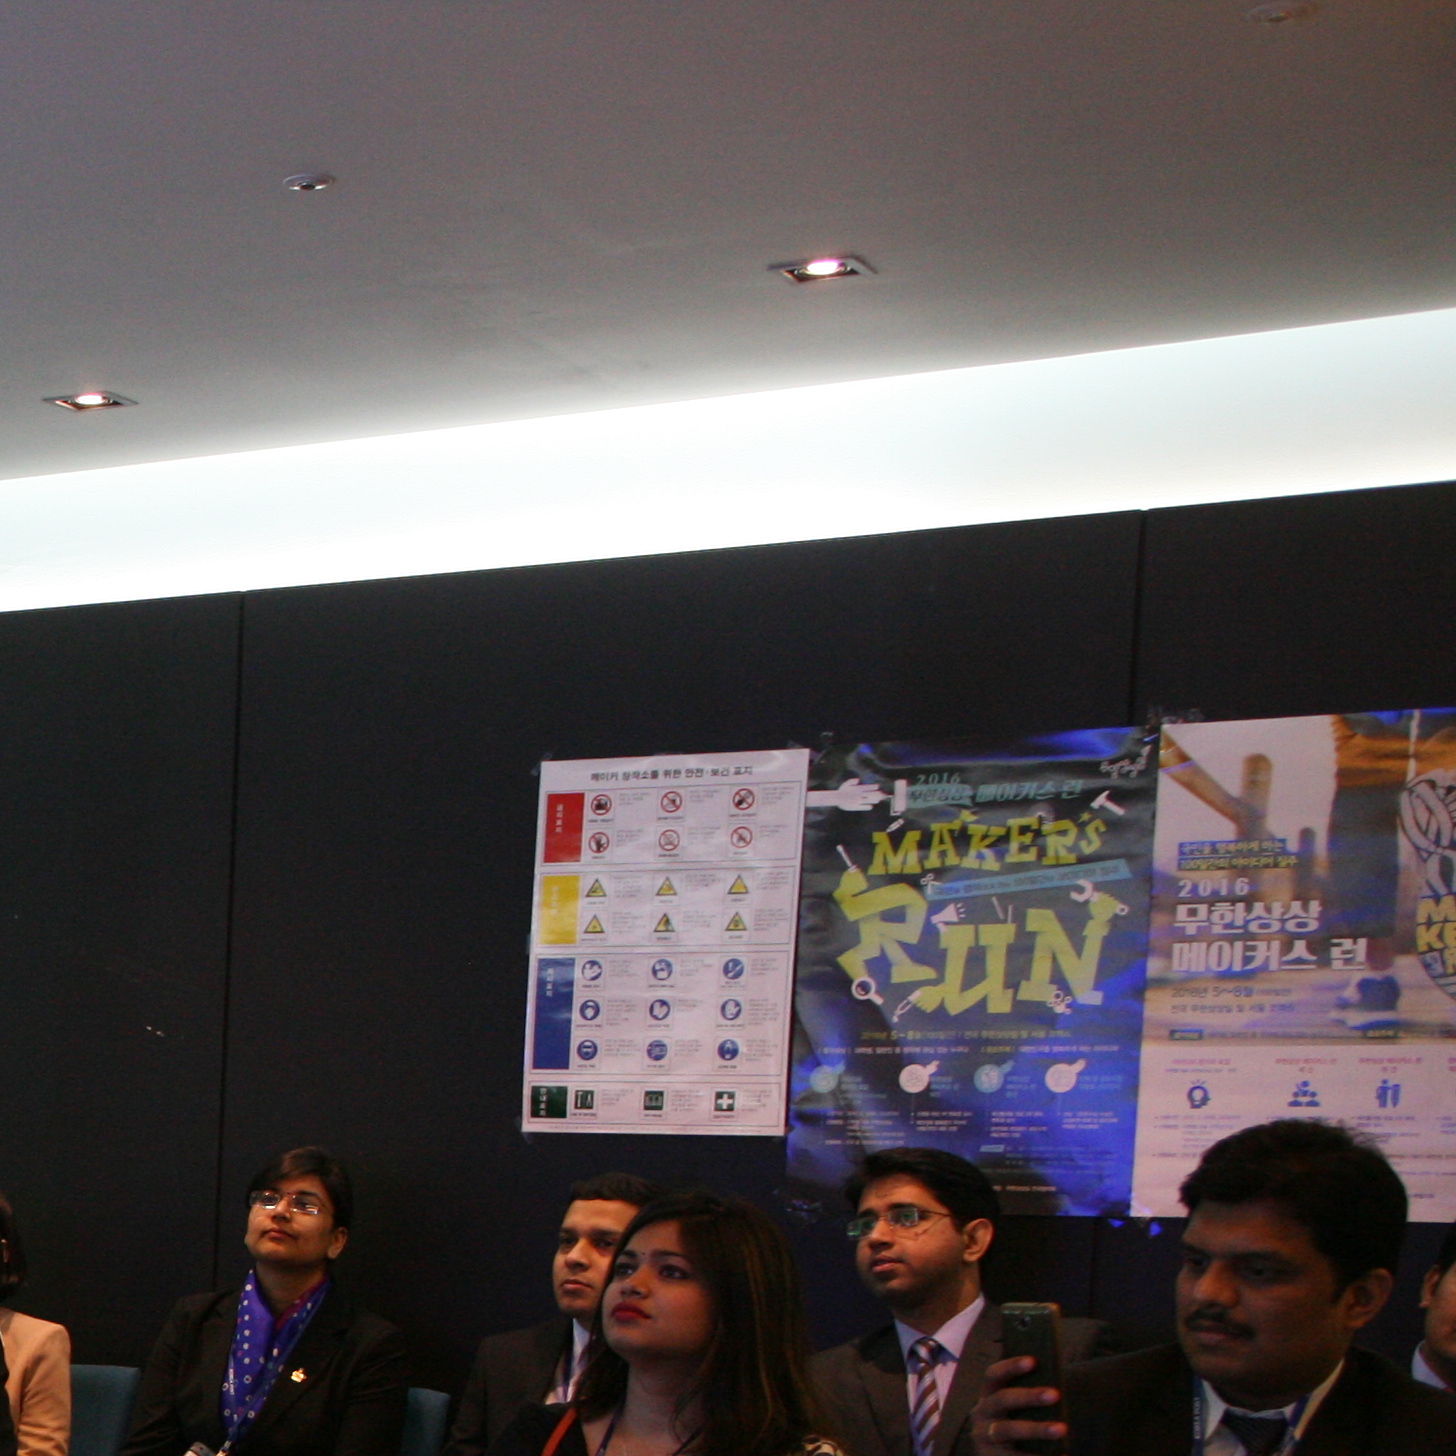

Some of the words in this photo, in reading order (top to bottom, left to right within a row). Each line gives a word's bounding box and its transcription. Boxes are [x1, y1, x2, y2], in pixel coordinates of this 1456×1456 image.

[917, 772, 961, 786] 2016
[1178, 877, 1250, 898] 2016
[1174, 900, 1322, 935] 무한상상
[833, 868, 1114, 1016] RUN
[1172, 940, 1318, 972] 메이커스
[1329, 937, 1368, 971] 런
